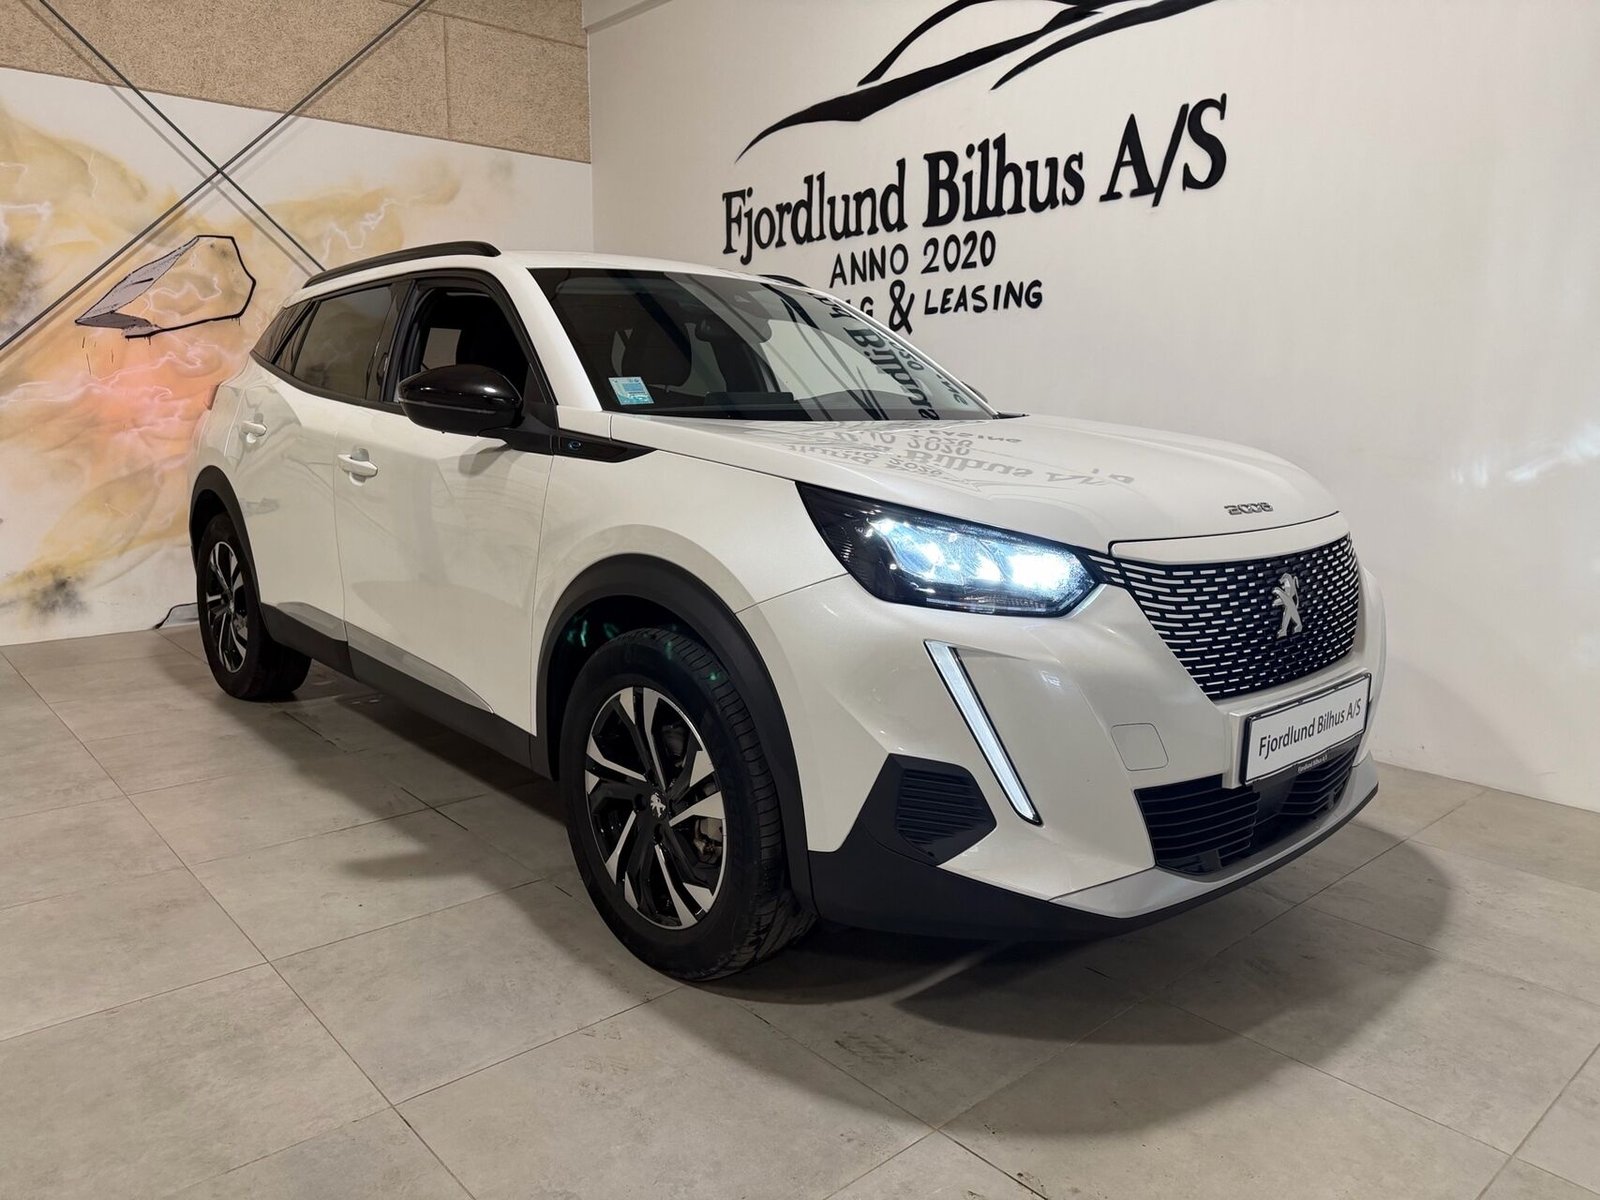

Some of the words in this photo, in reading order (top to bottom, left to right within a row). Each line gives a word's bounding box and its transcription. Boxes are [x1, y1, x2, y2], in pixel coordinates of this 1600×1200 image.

[721, 157, 908, 266] Fjordlund
[921, 132, 1085, 228] Bilhus
[1099, 93, 1228, 208] A/S
[829, 243, 909, 289] ANNO
[920, 230, 996, 275] 2020
[888, 279, 916, 336] &
[924, 279, 1043, 316] LEASING
[1258, 717, 1316, 760] Fjordlund
[1317, 709, 1345, 735] Bilhus
[1346, 698, 1361, 721] A/S
